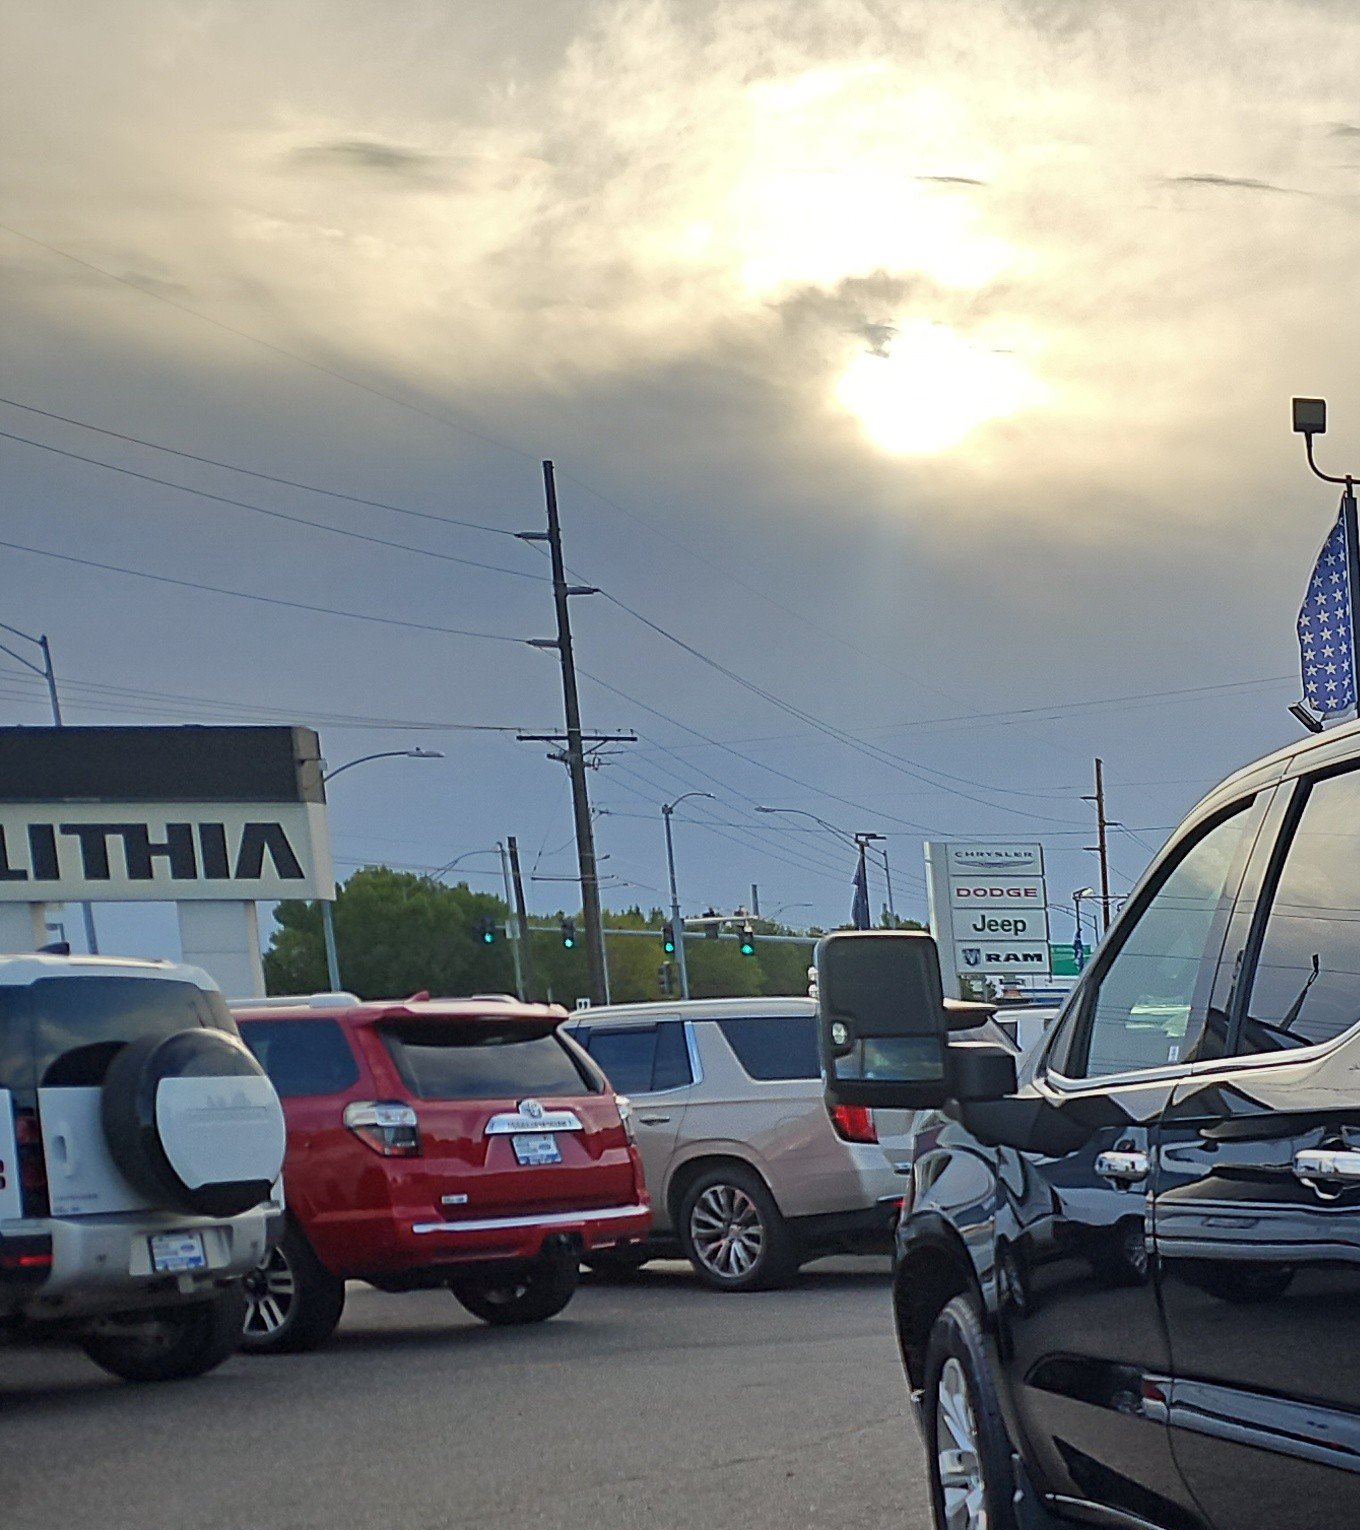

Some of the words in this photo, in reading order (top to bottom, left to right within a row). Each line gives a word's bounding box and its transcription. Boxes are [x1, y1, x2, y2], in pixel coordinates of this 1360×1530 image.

[956, 887, 1038, 898] DODGE
[972, 914, 1027, 936] Jeep
[985, 953, 1043, 962] RAM
